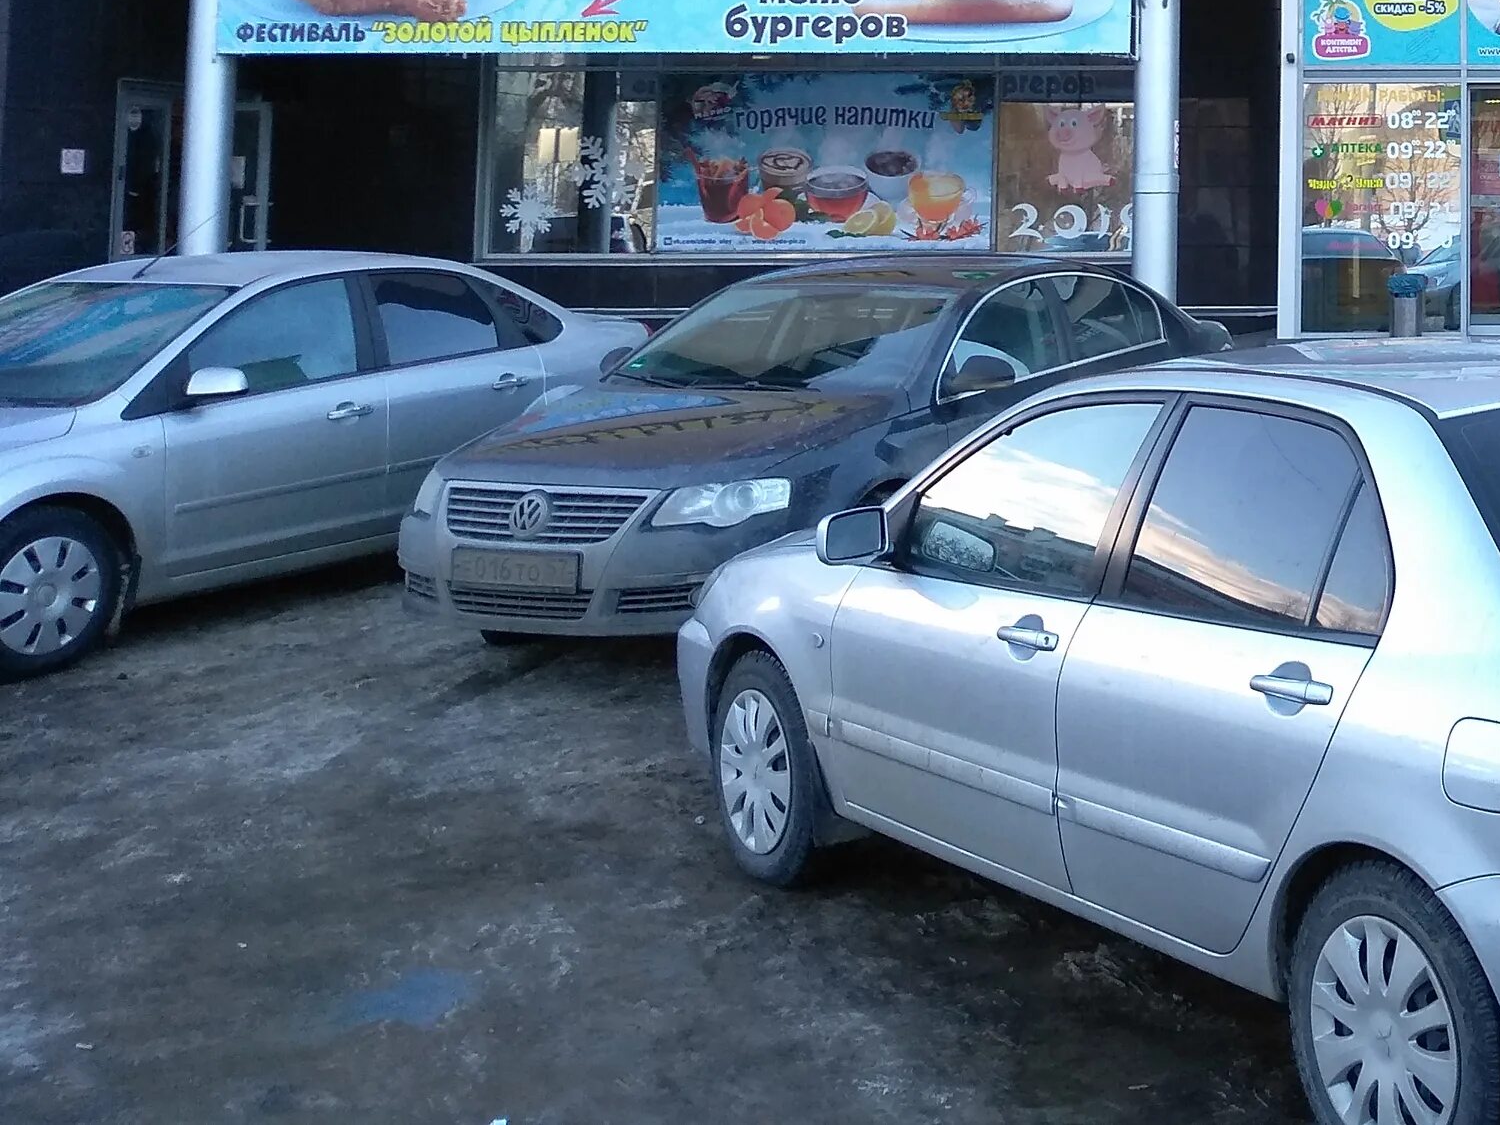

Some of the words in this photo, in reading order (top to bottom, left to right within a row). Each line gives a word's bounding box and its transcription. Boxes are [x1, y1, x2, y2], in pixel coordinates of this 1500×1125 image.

[1374, 2, 1415, 14] скидка
[236, 20, 367, 44] ФЕСТИВАЛЬ
[725, 4, 907, 44] бургеров
[736, 103, 828, 135] горячие
[834, 103, 936, 130] напитки
[1309, 116, 1379, 127] МАГНИТ
[1331, 142, 1383, 153] АПТЕКА
